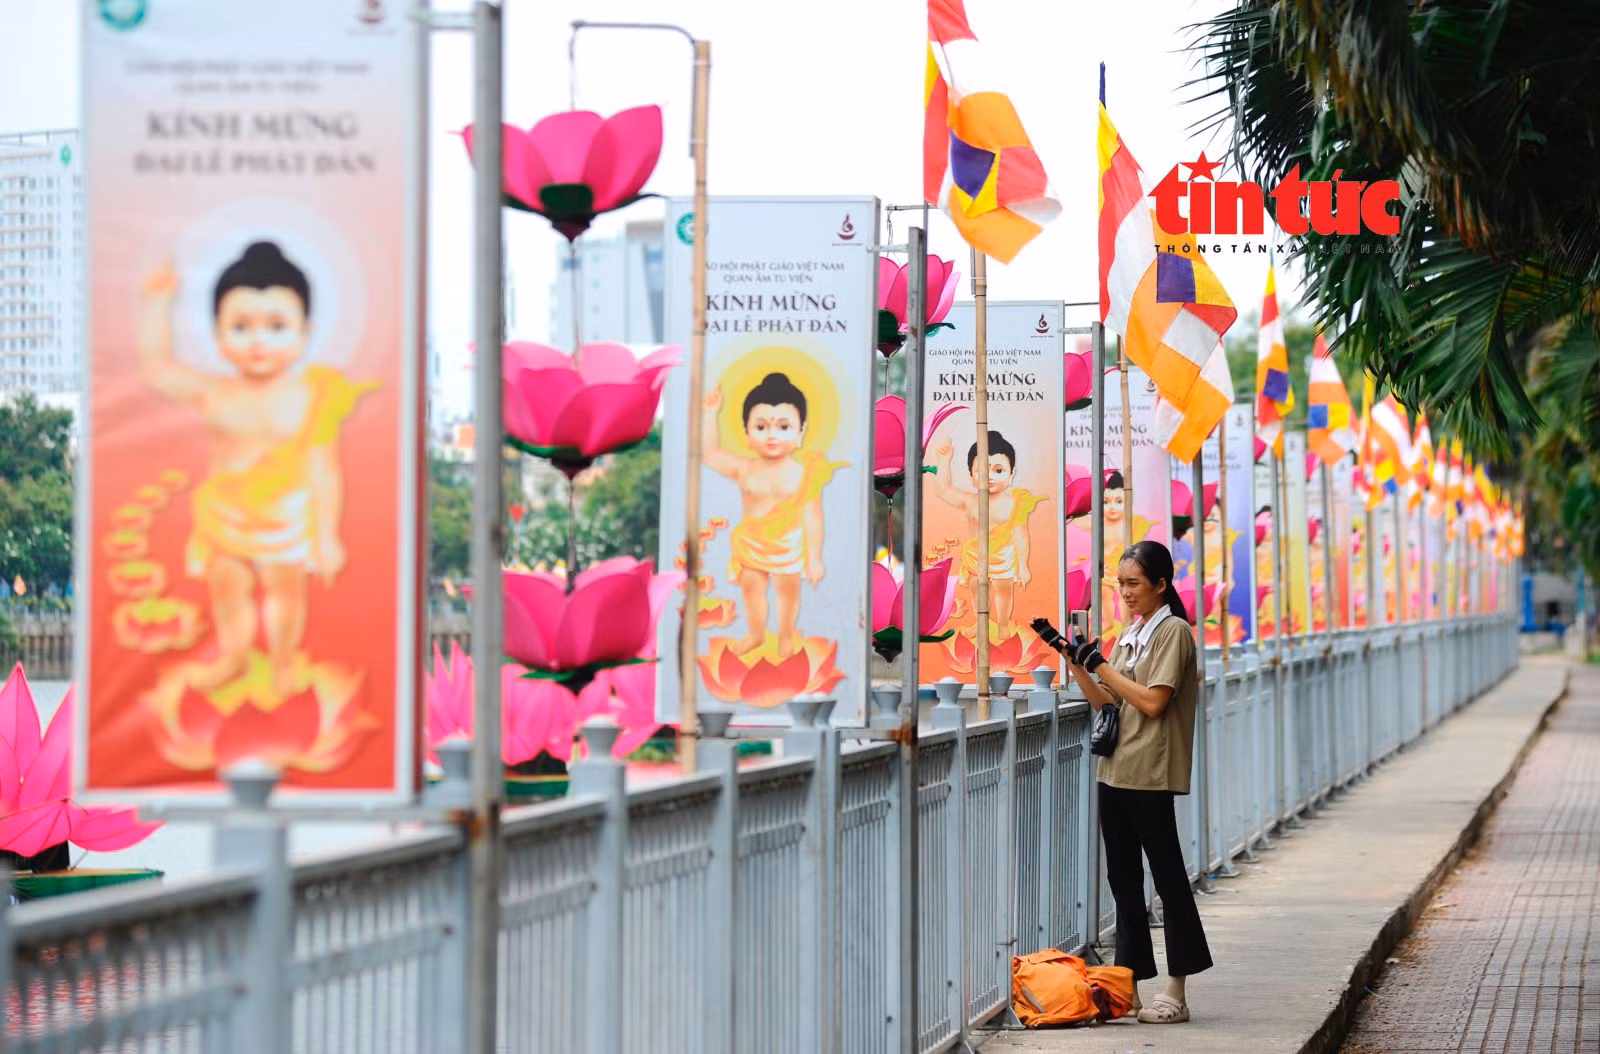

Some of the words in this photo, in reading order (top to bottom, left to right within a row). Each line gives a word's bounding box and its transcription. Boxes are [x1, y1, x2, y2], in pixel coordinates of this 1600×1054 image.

[769, 260, 794, 271] GIÁO
[797, 260, 819, 272] VIỆT
[821, 262, 845, 271] NAM
[723, 274, 752, 284] QUAN
[789, 272, 813, 284] VIỆN
[706, 291, 763, 311] KÍNH
[769, 290, 836, 311] MỪNG
[758, 315, 807, 334] PHẬT
[952, 358, 974, 366] QUAN
[986, 371, 1036, 386] MỪNG
[987, 389, 1013, 404] HẬT
[1070, 423, 1093, 437] KÍN
